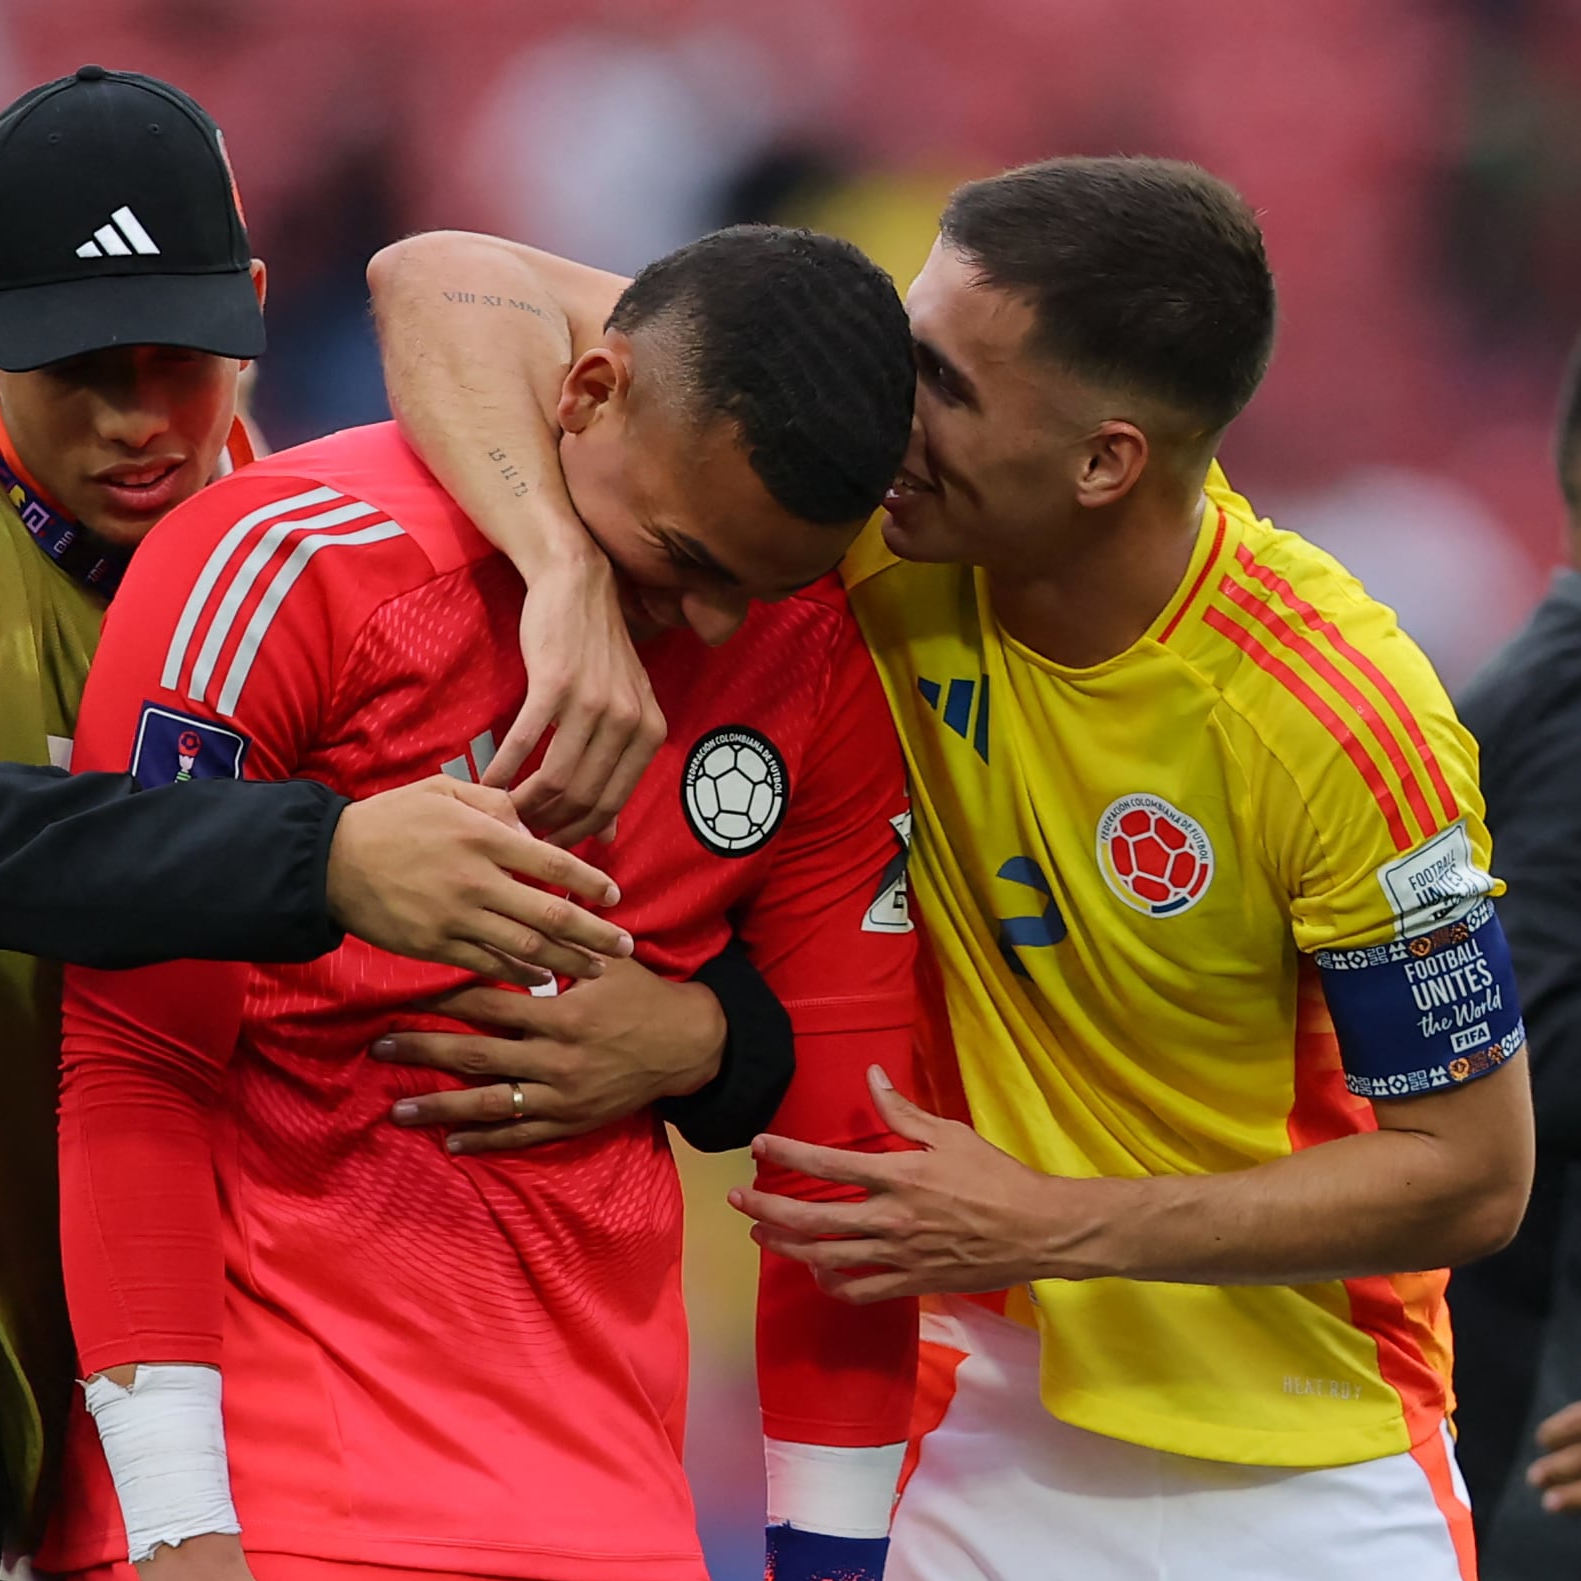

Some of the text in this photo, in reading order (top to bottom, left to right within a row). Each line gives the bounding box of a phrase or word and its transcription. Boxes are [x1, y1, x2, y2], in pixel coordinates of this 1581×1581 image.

[1408, 848, 1455, 891] FOOTBALL
[1403, 938, 1484, 984] FOOTBALL
[1411, 958, 1493, 1012] UNITES
[1416, 984, 1503, 1038] the World
[1454, 1028, 1489, 1051] FIFA
